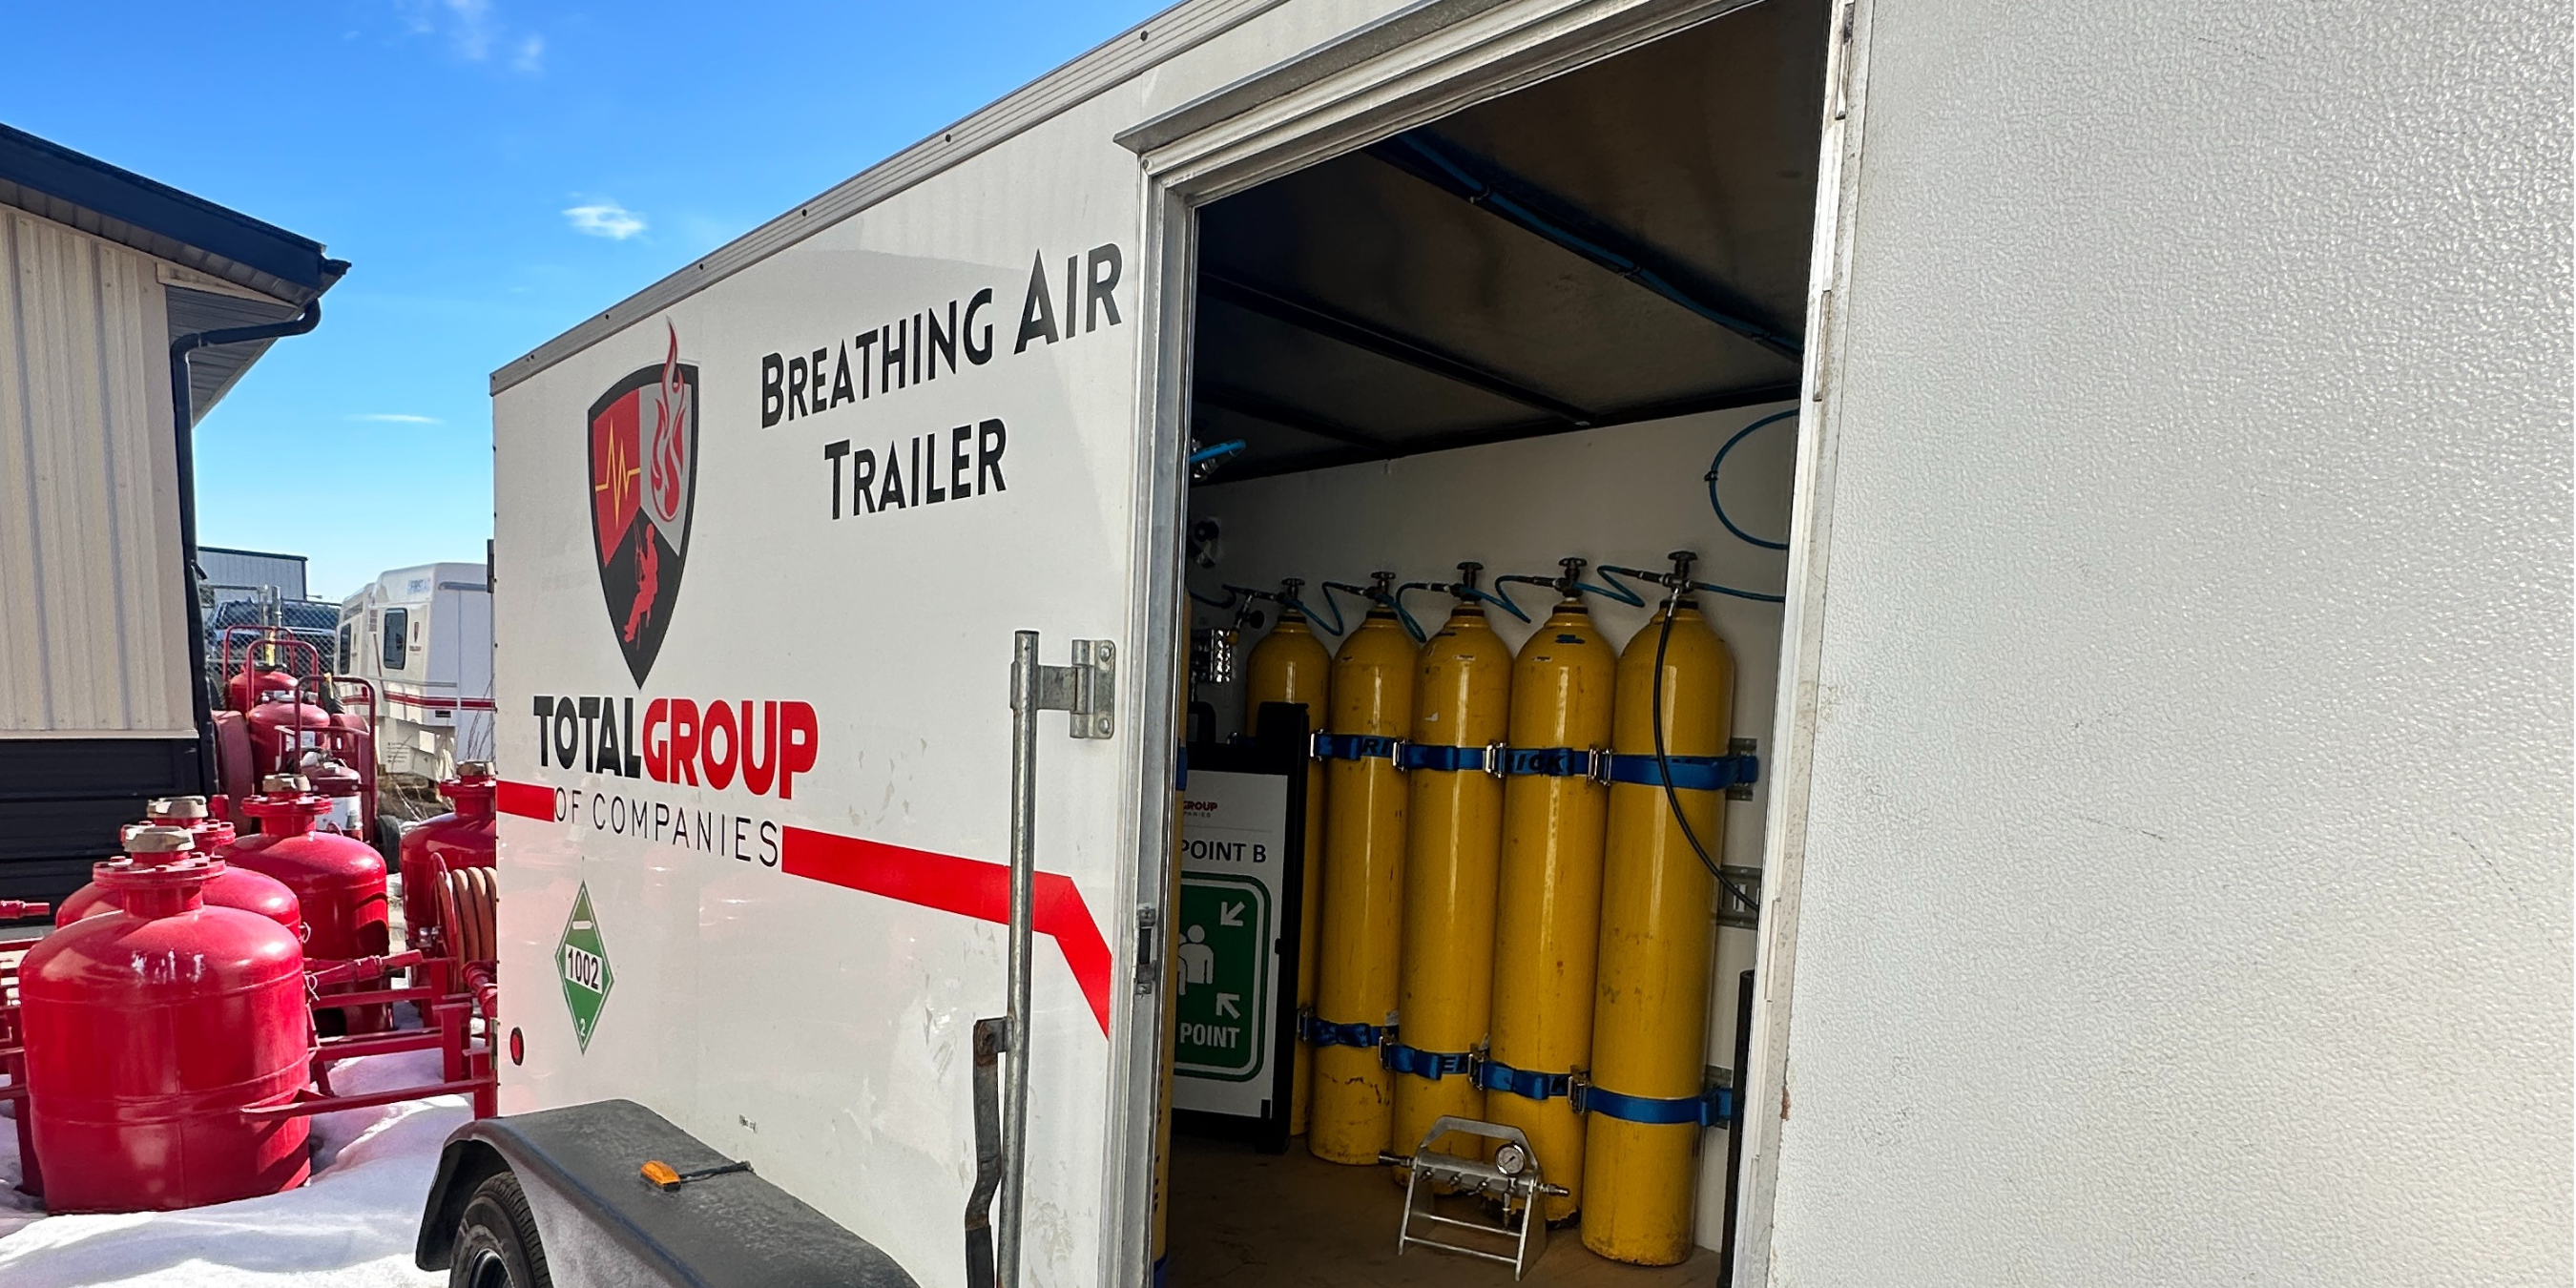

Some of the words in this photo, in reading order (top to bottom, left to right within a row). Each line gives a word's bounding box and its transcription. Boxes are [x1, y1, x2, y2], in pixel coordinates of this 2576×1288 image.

[761, 287, 993, 429] BREATHING
[1013, 243, 1122, 355] AIR
[824, 417, 1007, 520] TRAILER
[555, 786, 582, 824] OF
[592, 793, 779, 867] COMPANIES
[1253, 843, 1267, 863] B
[568, 948, 599, 990] 1002
[580, 1018, 586, 1037] 2
[1180, 1022, 1241, 1049] POINT
